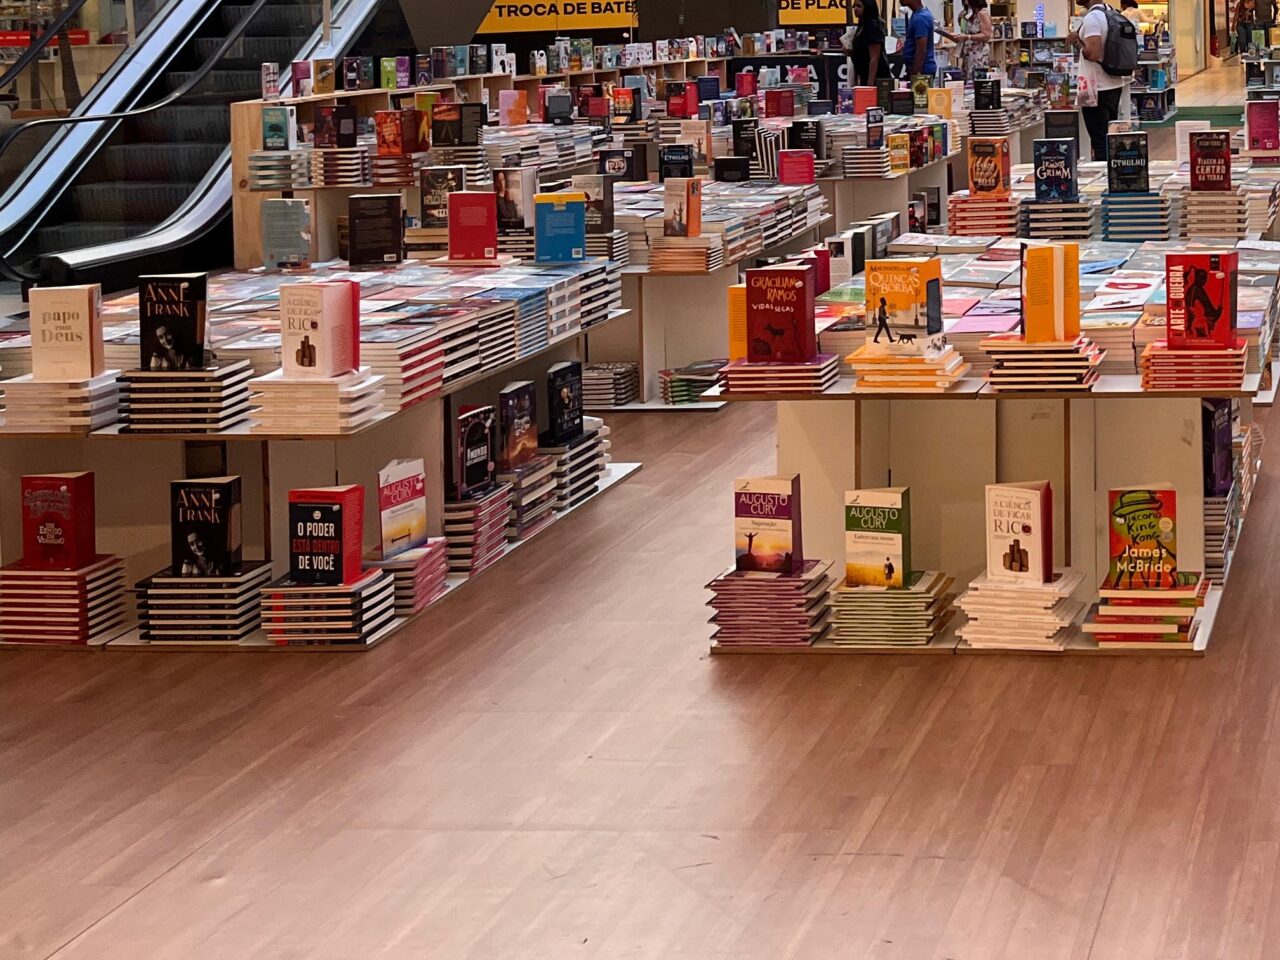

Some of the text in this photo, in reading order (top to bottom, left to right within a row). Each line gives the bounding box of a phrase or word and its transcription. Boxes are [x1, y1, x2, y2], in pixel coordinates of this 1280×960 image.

[495, 4, 559, 17] TROCA
[563, 2, 588, 15] DE
[742, 64, 818, 80] CIXA
[1111, 159, 1146, 168] CTHULHU
[1196, 165, 1226, 175] CENTRO
[1036, 165, 1071, 180] GRIMM
[751, 276, 801, 289] GRACILIAN
[870, 271, 921, 288] QUINCAS
[766, 289, 798, 303] RAMOS
[880, 282, 915, 296] BORBA
[1170, 264, 1185, 332] ARTE GUERRA
[146, 302, 189, 319] FRANK
[751, 303, 795, 314] VIDAS SECAS
[41, 310, 80, 324] papo
[41, 327, 83, 343] Deus
[390, 489, 414, 504] CURY
[739, 493, 788, 507] AUGUSTO
[178, 508, 221, 524] FRANK
[750, 503, 778, 515] CURY
[850, 507, 899, 520] AUGUSTO
[297, 522, 335, 537] O PODER
[860, 516, 888, 529] CURY
[1122, 544, 1167, 558] James
[298, 554, 335, 570] DE VOCÊ
[1117, 559, 1172, 572] McBride
